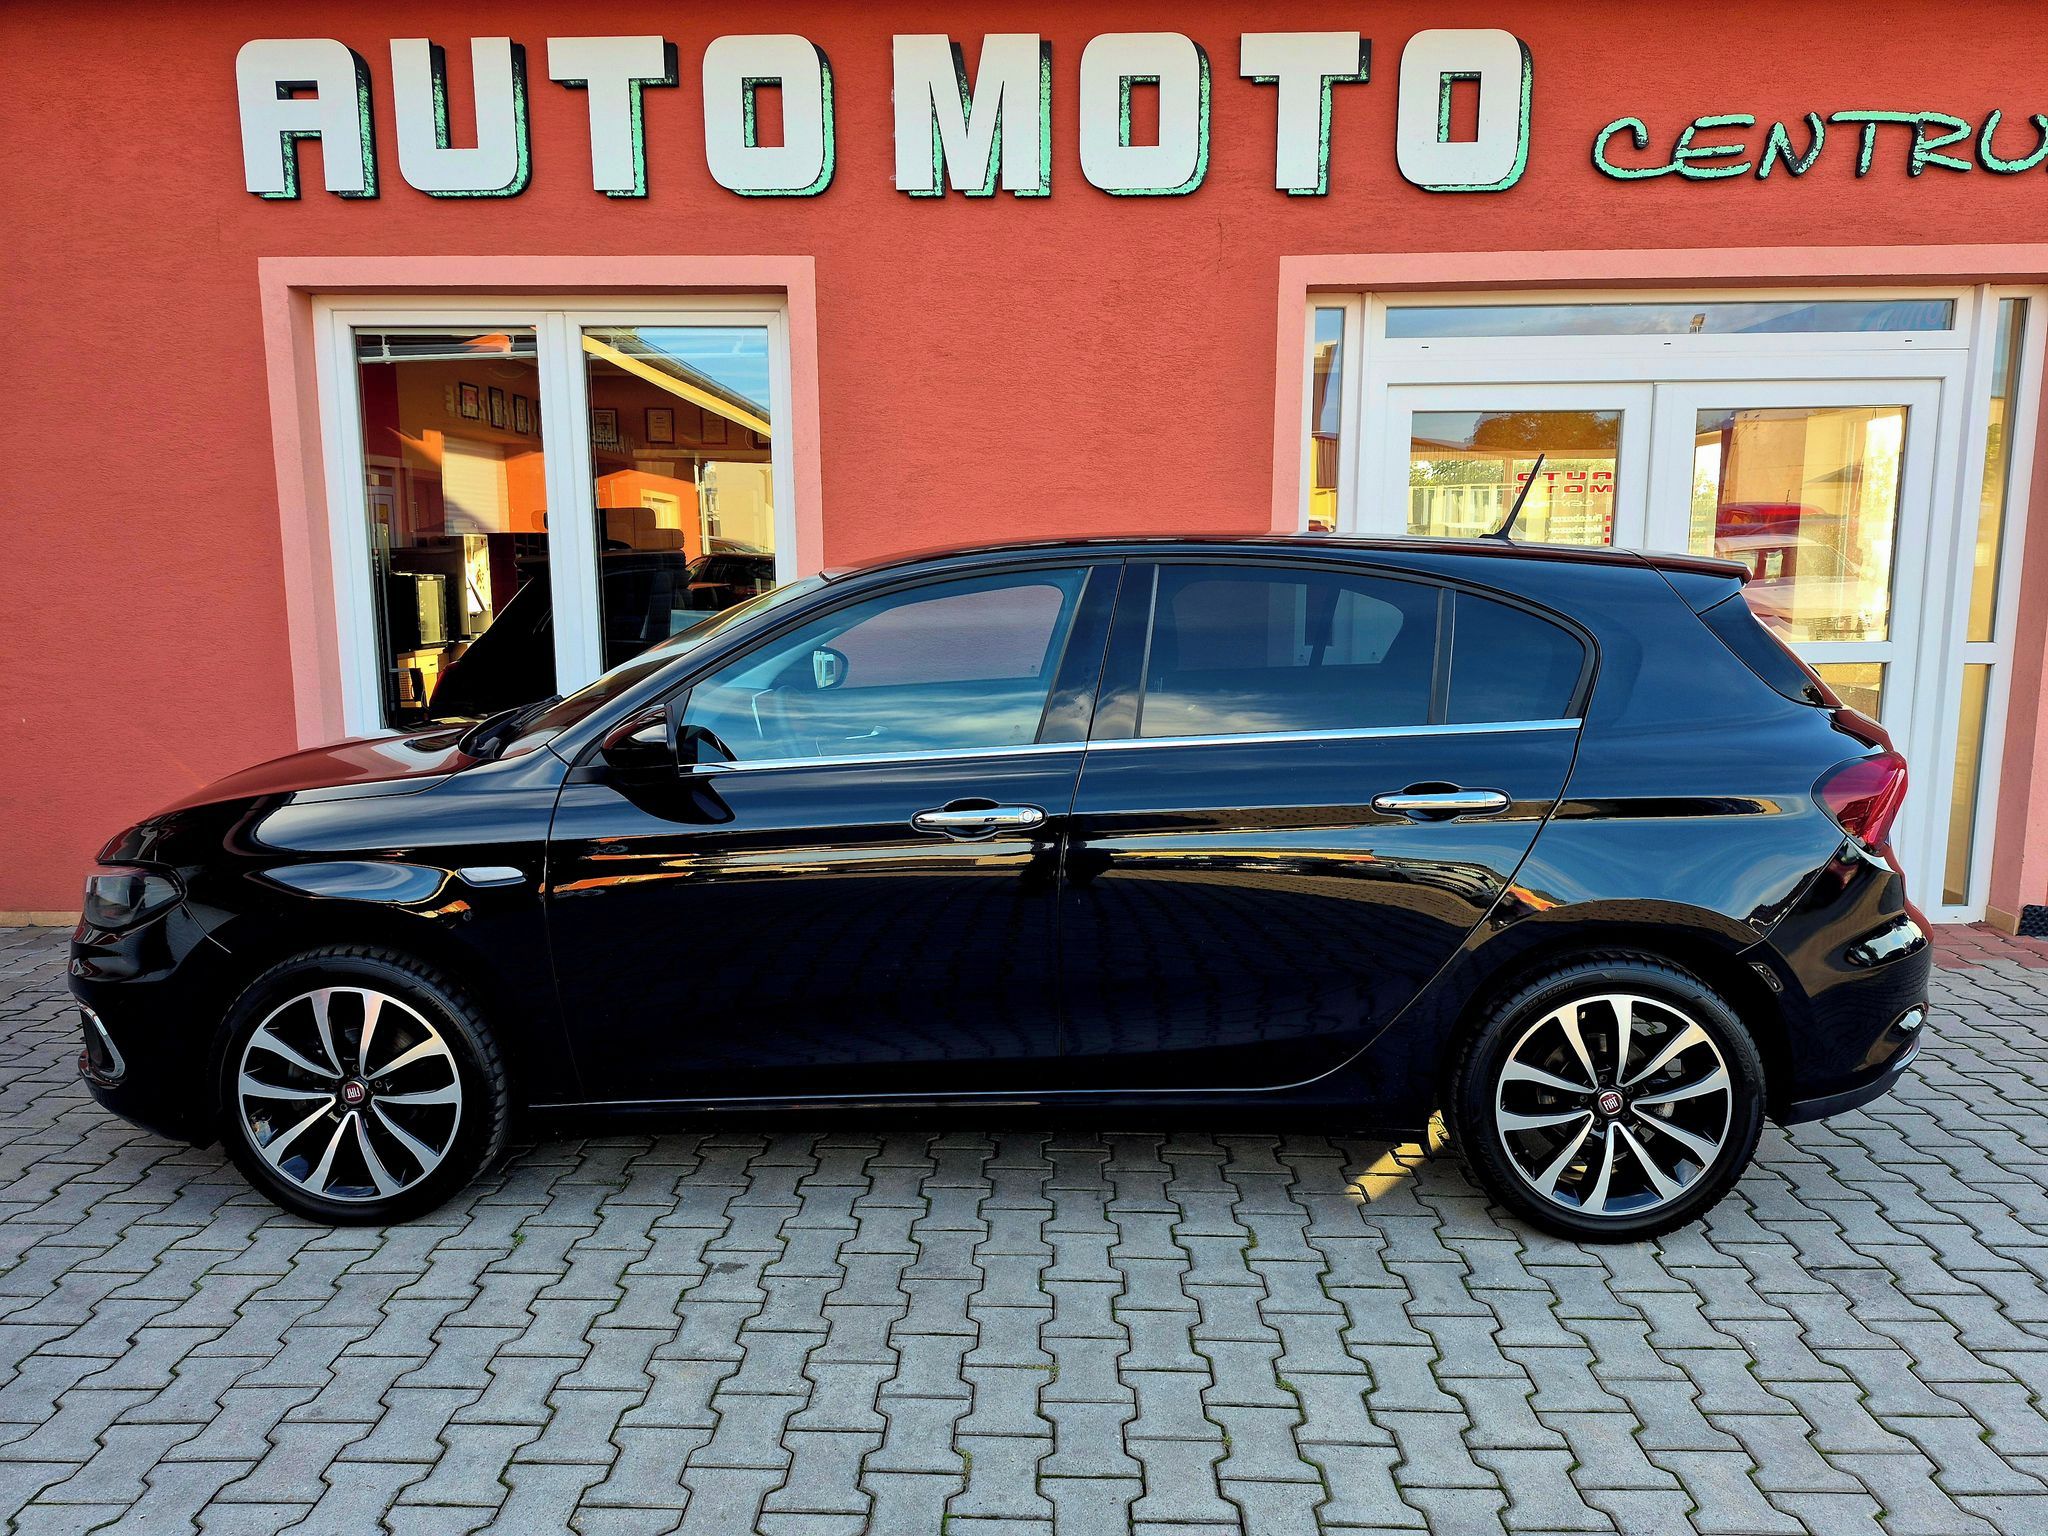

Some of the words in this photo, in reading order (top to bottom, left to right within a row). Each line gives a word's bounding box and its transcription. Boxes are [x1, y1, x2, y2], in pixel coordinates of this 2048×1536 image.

[236, 34, 836, 199] AUTO
[893, 28, 1533, 198] MOTO
[1591, 109, 2048, 180] CENTRU
[1602, 1096, 1619, 1111] FIAT
